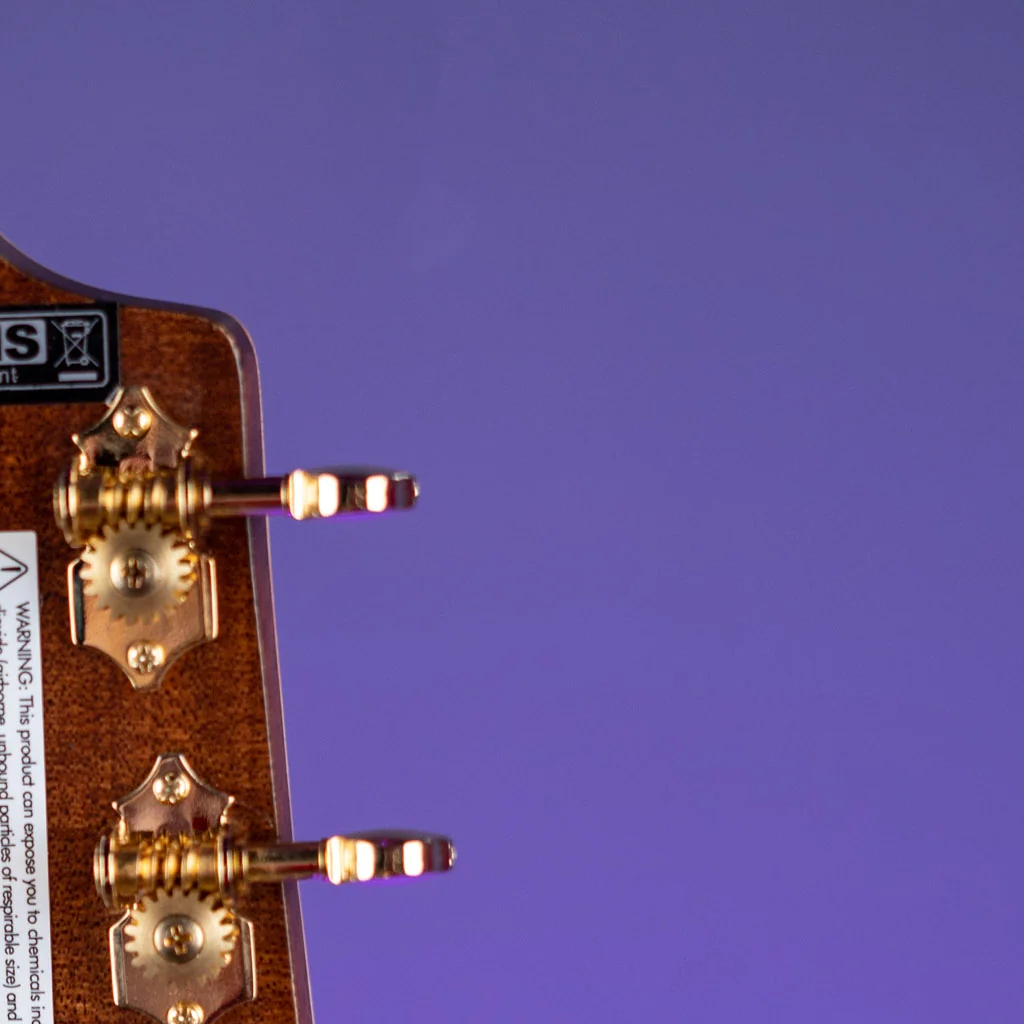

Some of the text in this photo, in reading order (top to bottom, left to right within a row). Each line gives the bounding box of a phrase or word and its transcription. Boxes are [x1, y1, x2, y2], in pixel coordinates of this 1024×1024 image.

[16, 601, 33, 690] WARNING:
[20, 695, 34, 725] This
[17, 730, 36, 786] product
[22, 791, 33, 818] can
[21, 823, 36, 875] expose
[1, 866, 18, 882] of
[22, 878, 36, 906] you
[0, 885, 20, 955] respirable
[27, 910, 40, 924] to
[3, 959, 21, 988] size)
[28, 929, 45, 1002] chemicals
[6, 992, 22, 1021] and
